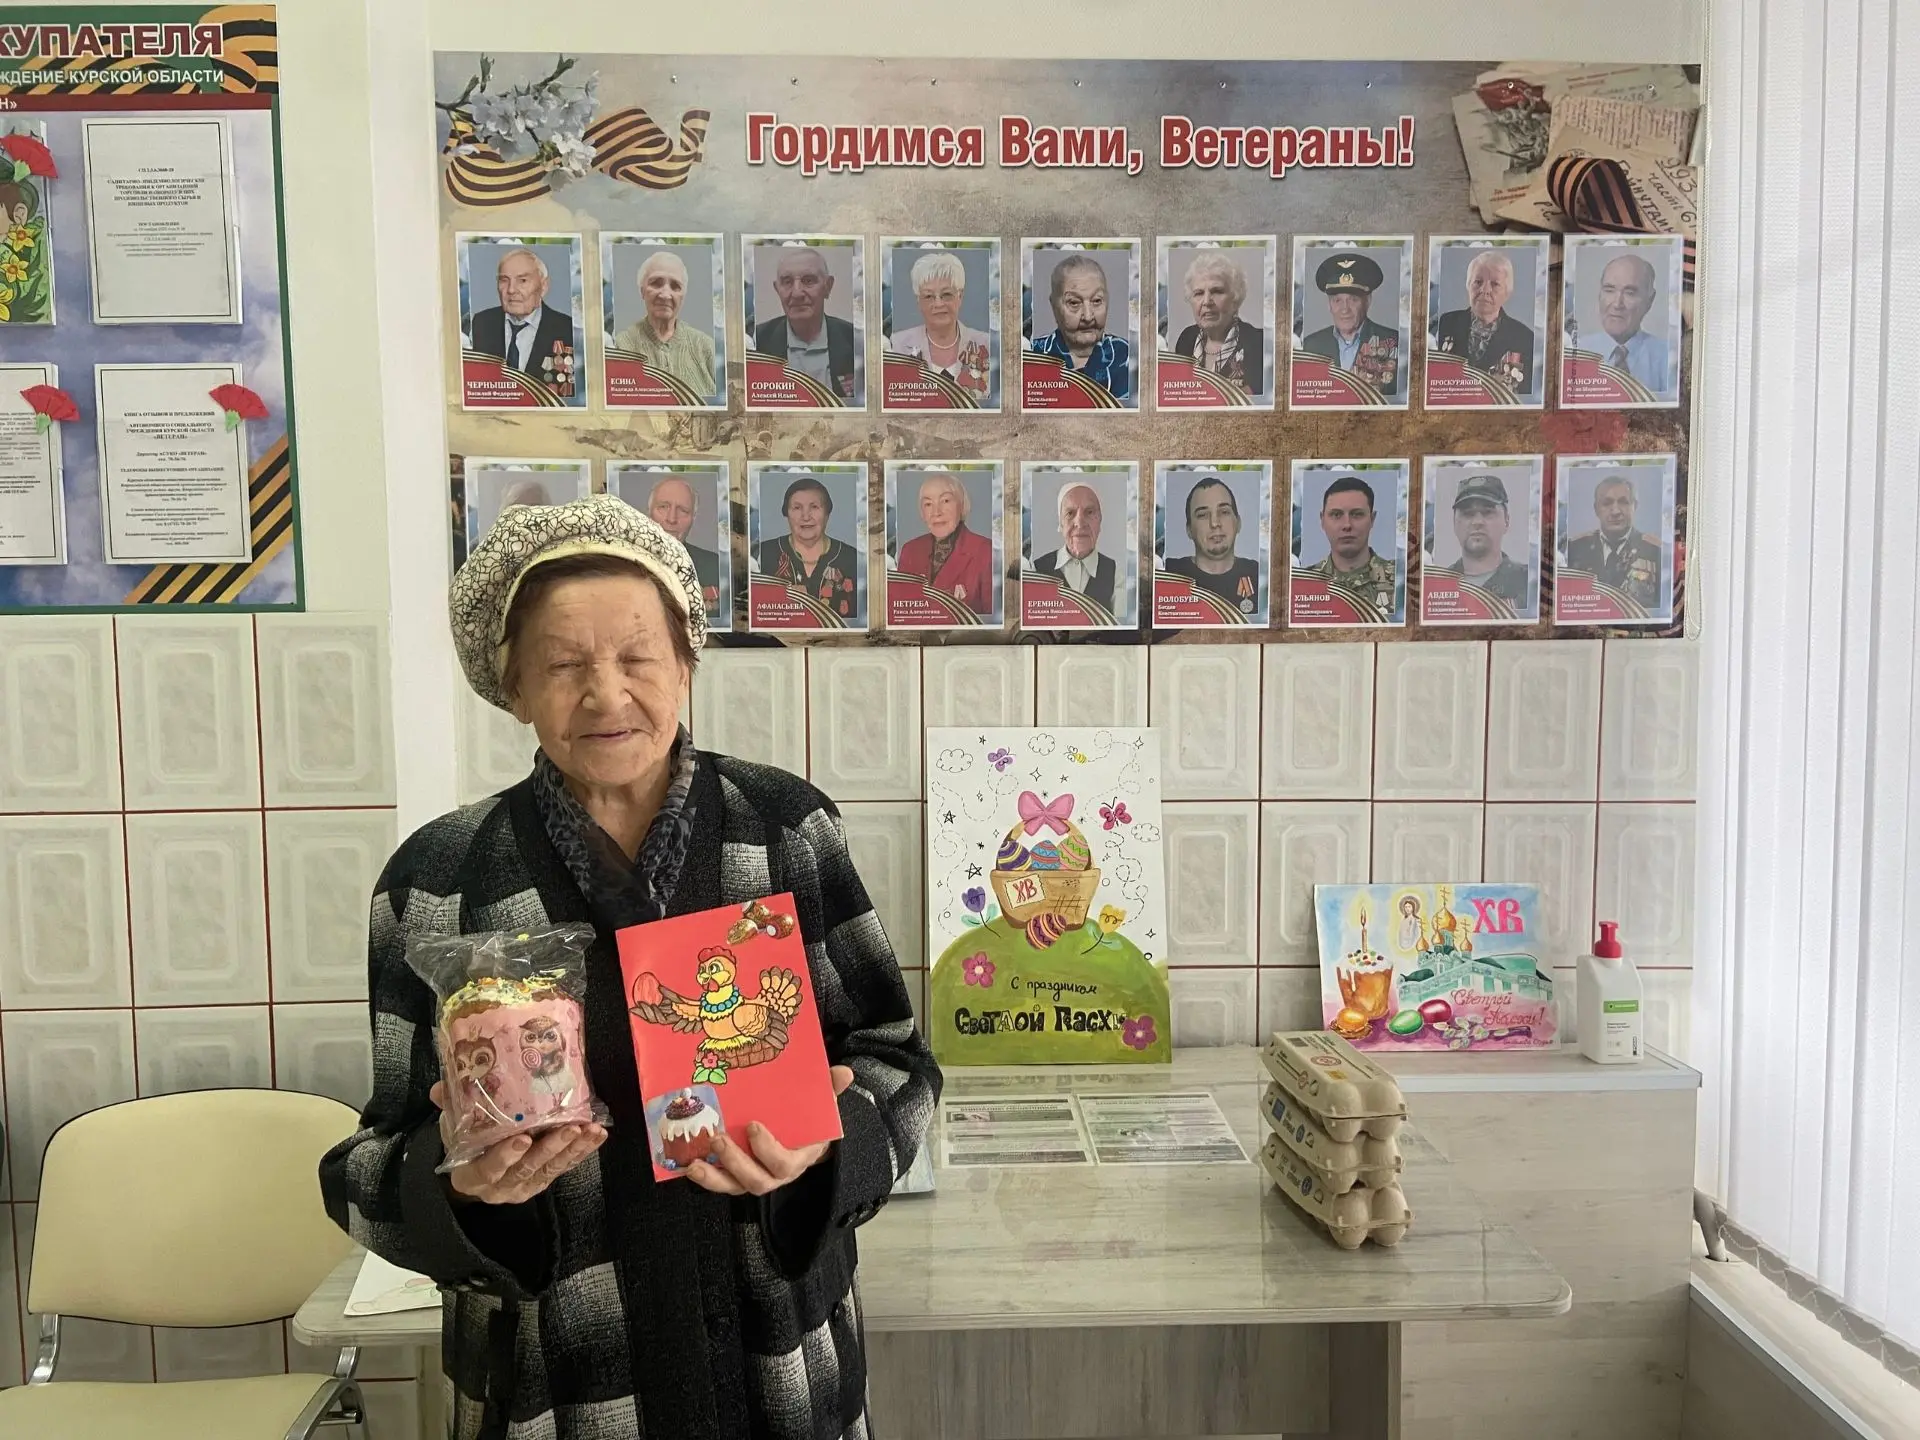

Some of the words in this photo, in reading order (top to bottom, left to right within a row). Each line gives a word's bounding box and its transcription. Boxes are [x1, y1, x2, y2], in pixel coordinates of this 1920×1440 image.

[69, 67, 143, 84] КУРСКОЙ
[147, 69, 224, 84] ОБЛАСТИ
[746, 112, 985, 177] Гордимся
[998, 112, 1145, 176] Вами,
[1160, 112, 1416, 179] Ветераны!
[467, 381, 517, 389] ЧЕРНЫШЕВ
[751, 382, 795, 390] СОРОКИН
[1430, 379, 1482, 387] ПРОСКУРЯКОВА
[1294, 594, 1331, 602] УЛЬЯНОВ
[1427, 591, 1460, 599] АВДЕЕВ
[1561, 594, 1601, 602] ПАРФЕНОВ
[1013, 879, 1039, 904] ХВ
[1471, 897, 1524, 934] ХВ
[1011, 977, 1020, 990] С
[1026, 979, 1097, 1001] праздником
